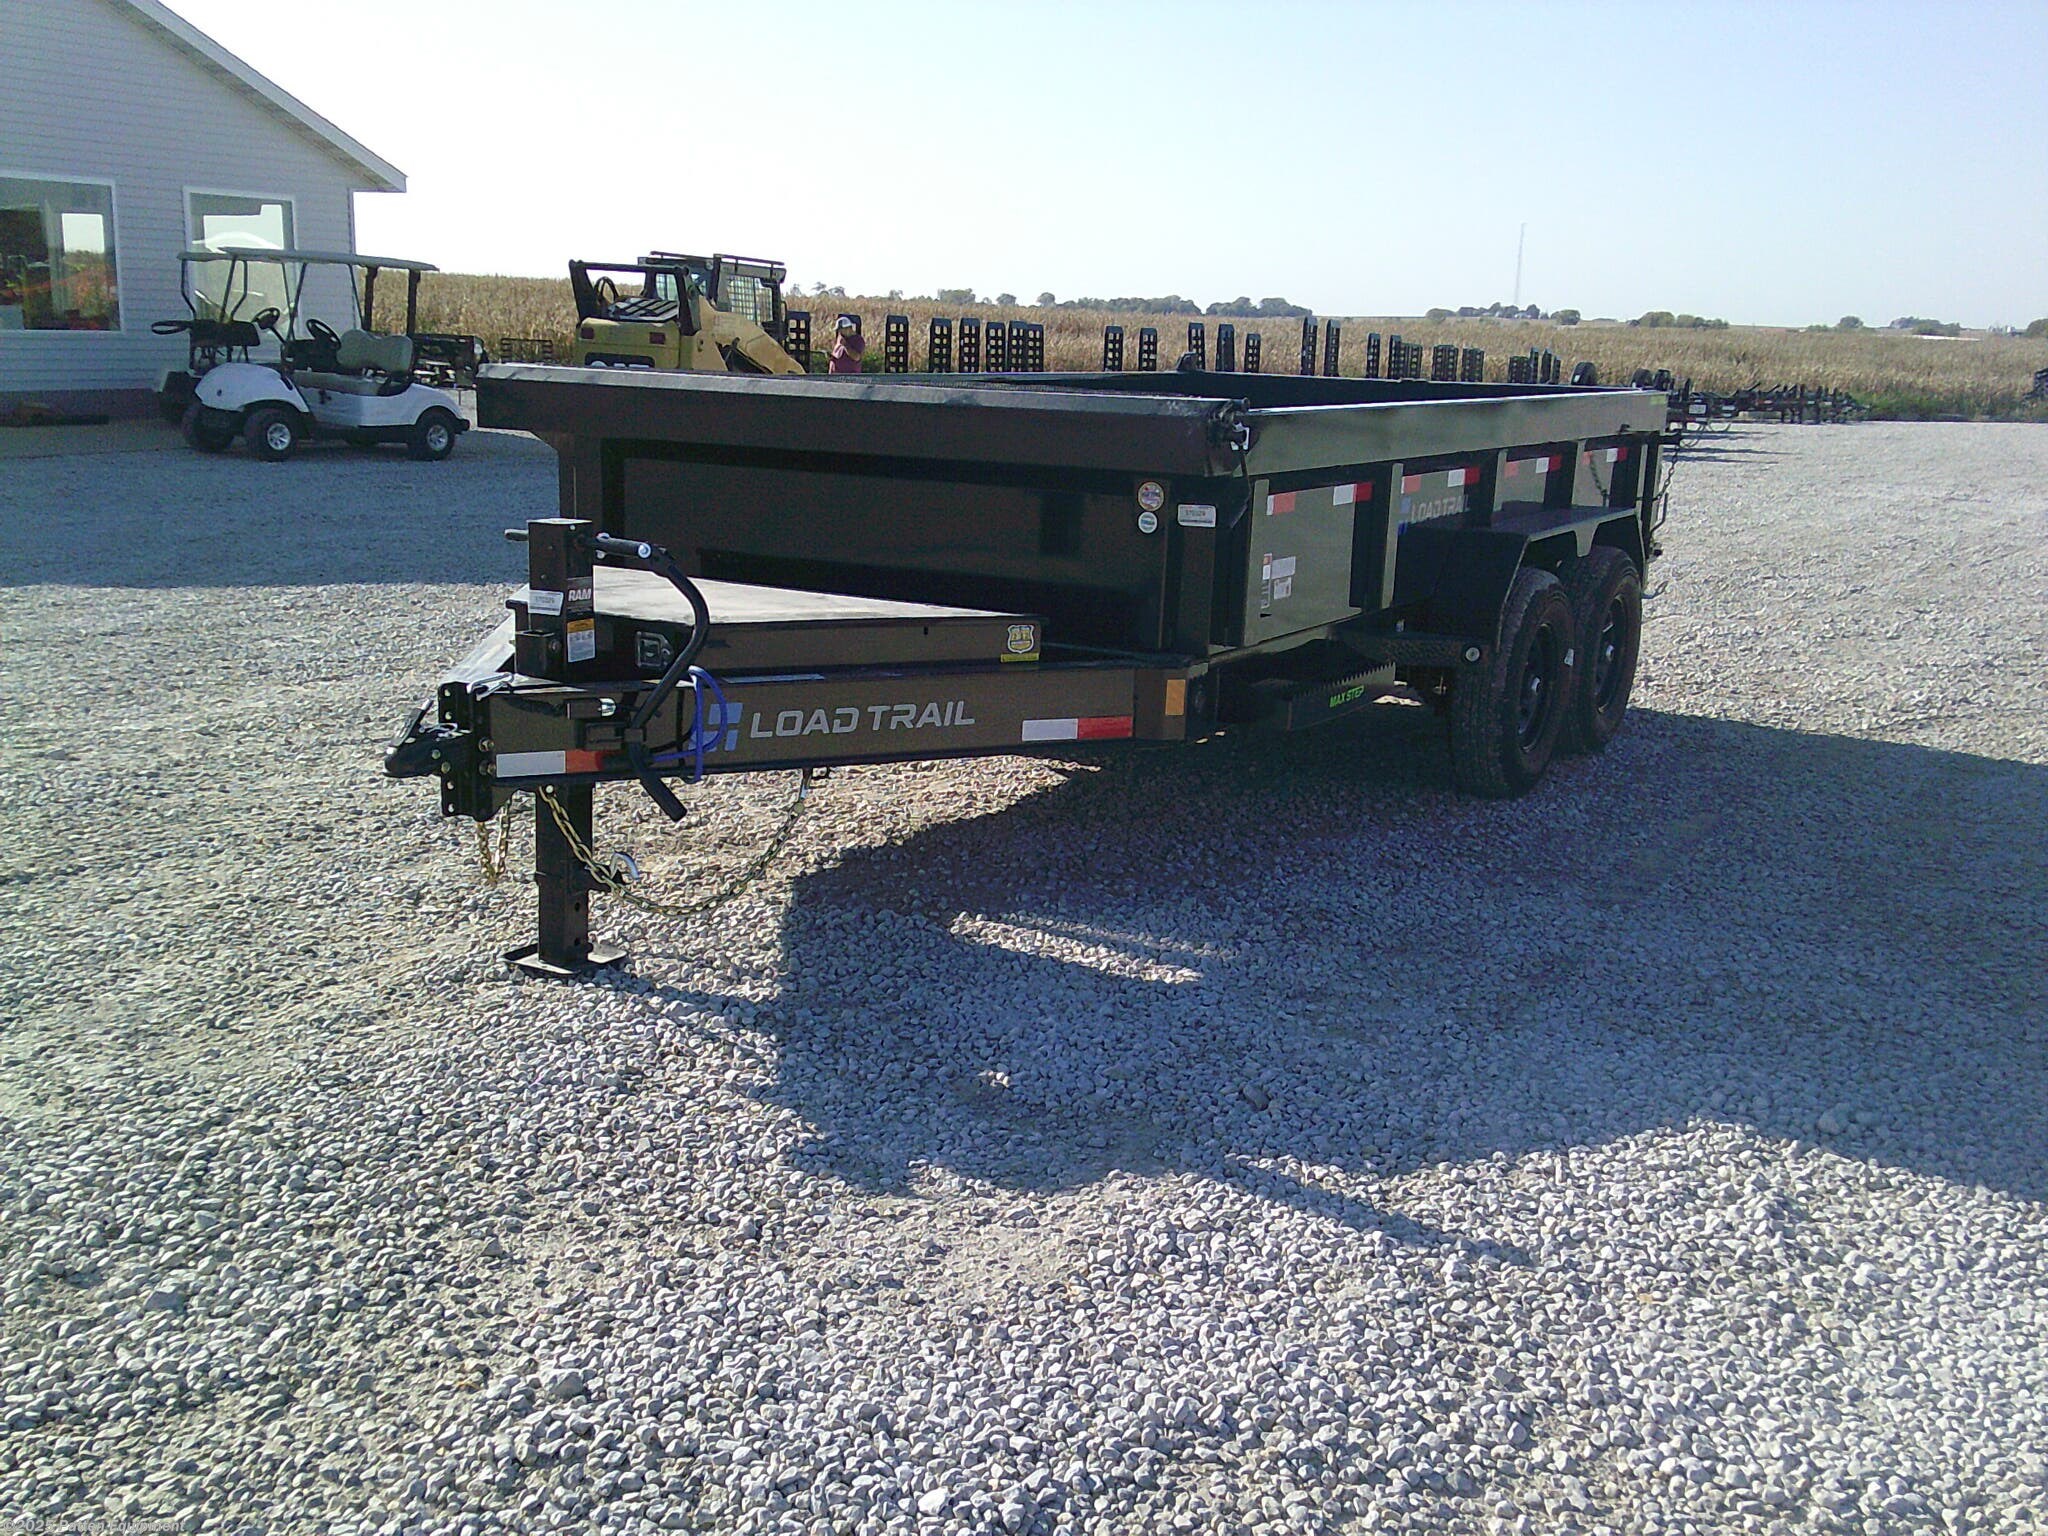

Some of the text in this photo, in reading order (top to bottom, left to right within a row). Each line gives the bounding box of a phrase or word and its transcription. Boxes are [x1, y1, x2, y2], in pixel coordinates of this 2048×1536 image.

[568, 588, 592, 602] RAM
[1329, 685, 1365, 708] MAX STEP
[750, 700, 976, 739] LOAD TRAIL
